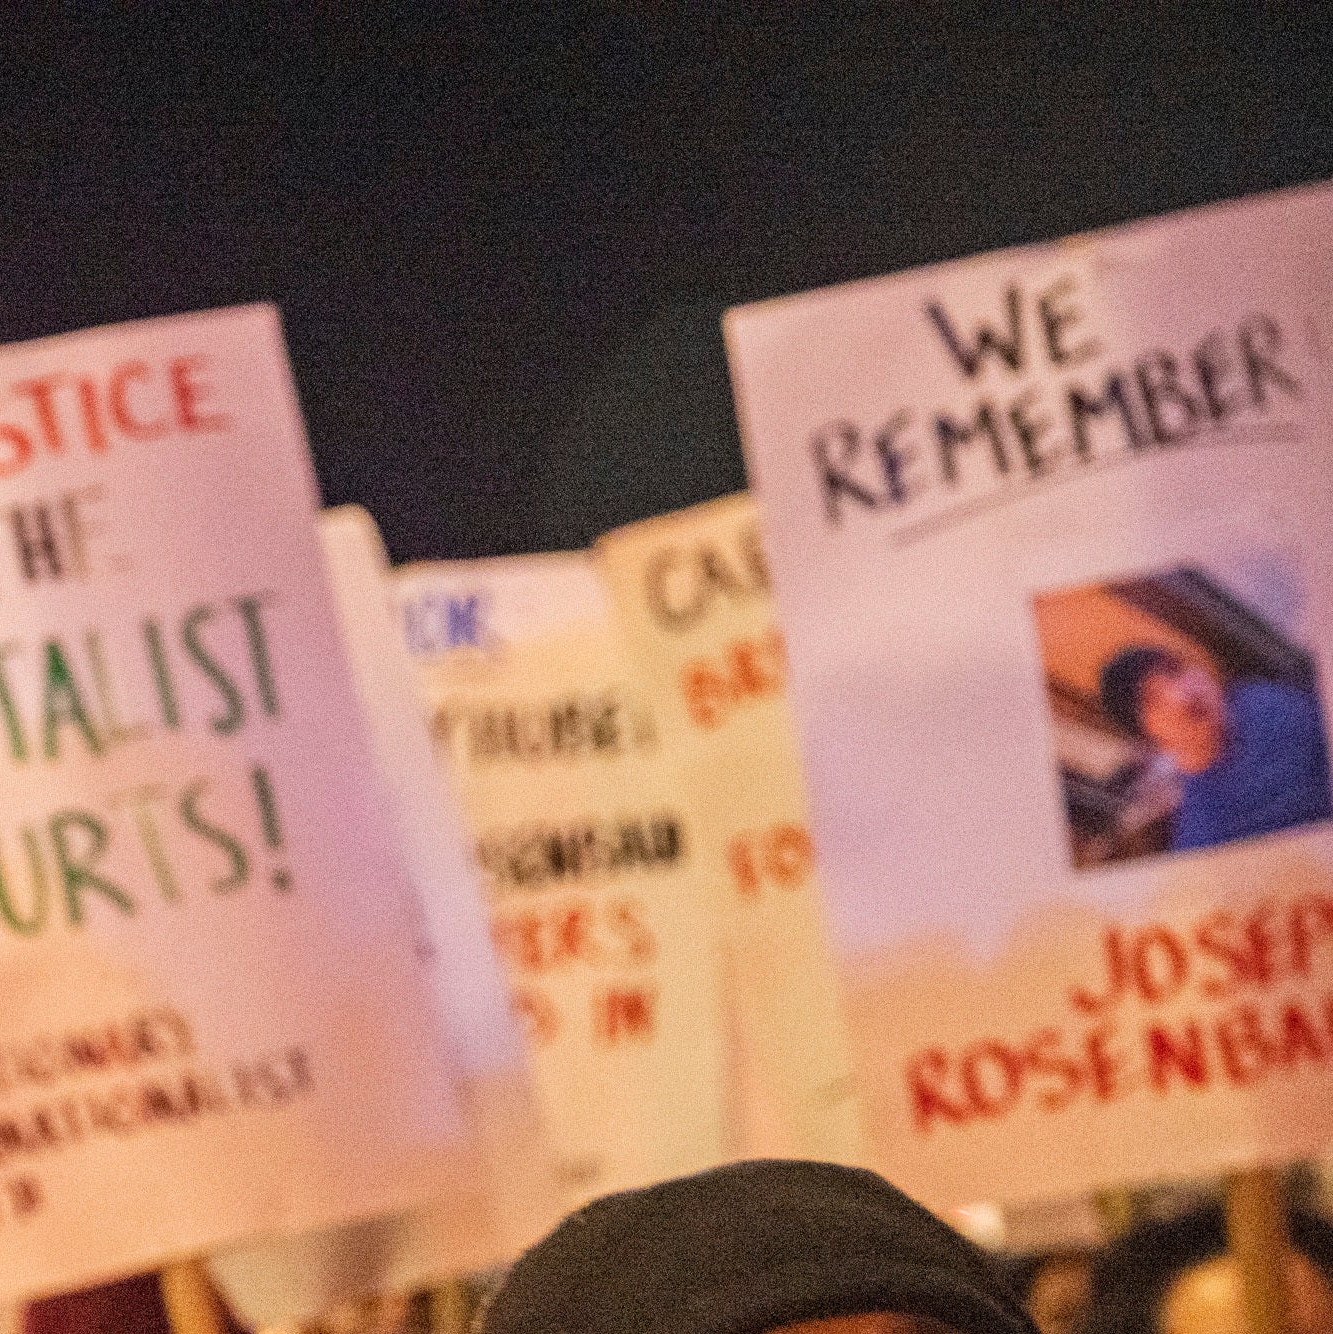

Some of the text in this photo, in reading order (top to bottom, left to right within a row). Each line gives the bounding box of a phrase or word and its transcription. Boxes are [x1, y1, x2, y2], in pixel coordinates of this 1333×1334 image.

[925, 273, 1103, 380] WE
[810, 311, 1301, 528] REMEMBER
[1066, 893, 1333, 1015] JOSEP
[904, 1000, 1333, 1137] ROSENBA
